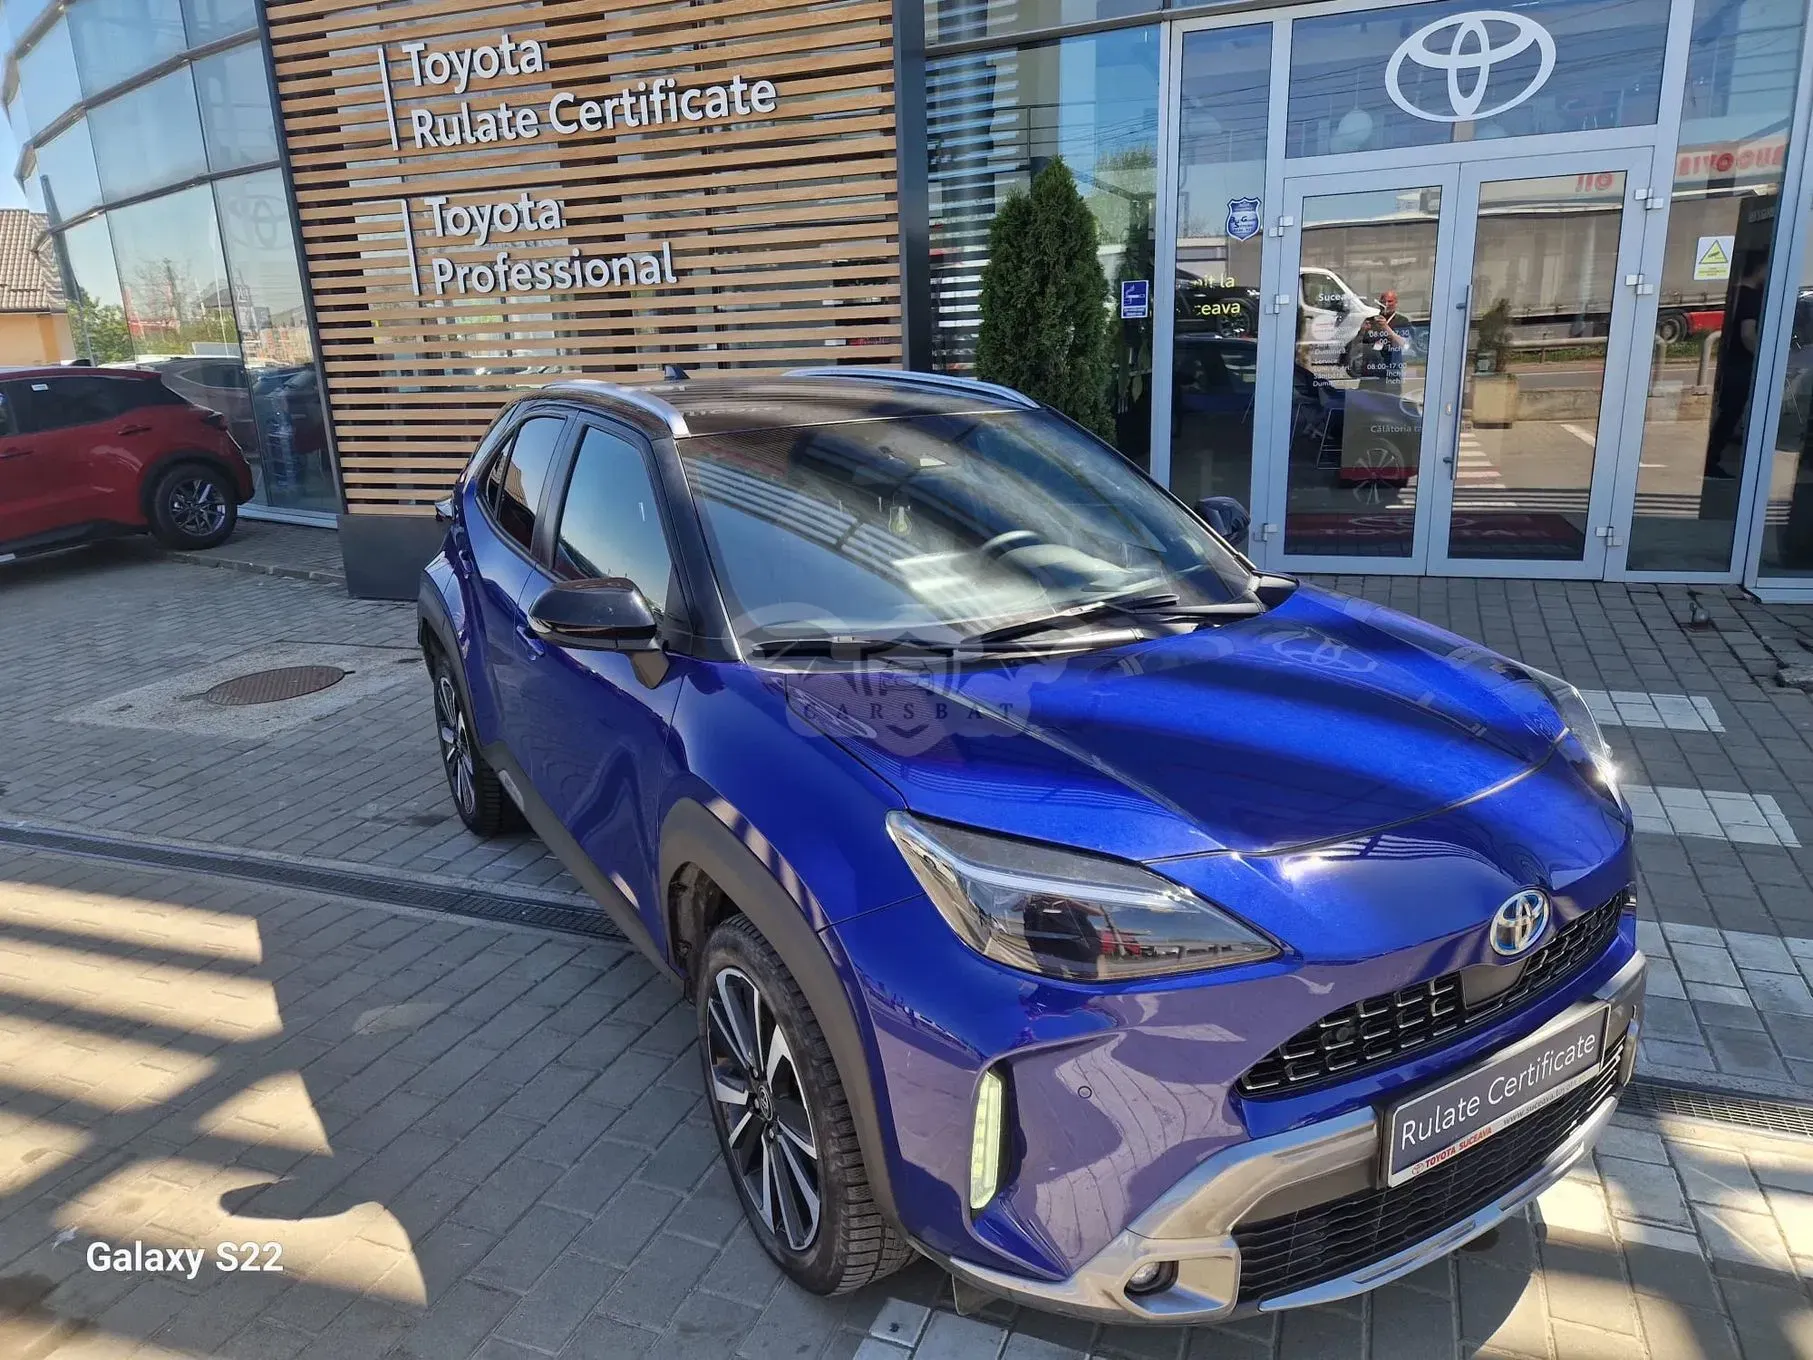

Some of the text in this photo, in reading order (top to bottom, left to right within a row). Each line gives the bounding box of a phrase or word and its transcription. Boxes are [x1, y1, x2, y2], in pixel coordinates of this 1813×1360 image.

[402, 33, 545, 94] Toyota
[411, 75, 778, 149] Rulate Certificate
[424, 192, 563, 246] Toyota
[432, 241, 678, 295] Professional
[1220, 272, 1235, 288] la
[1401, 1033, 1596, 1151] Rulate Certificate
[1423, 1145, 1457, 1169] TOYOTA
[1458, 1125, 1494, 1151] SUCEAVA
